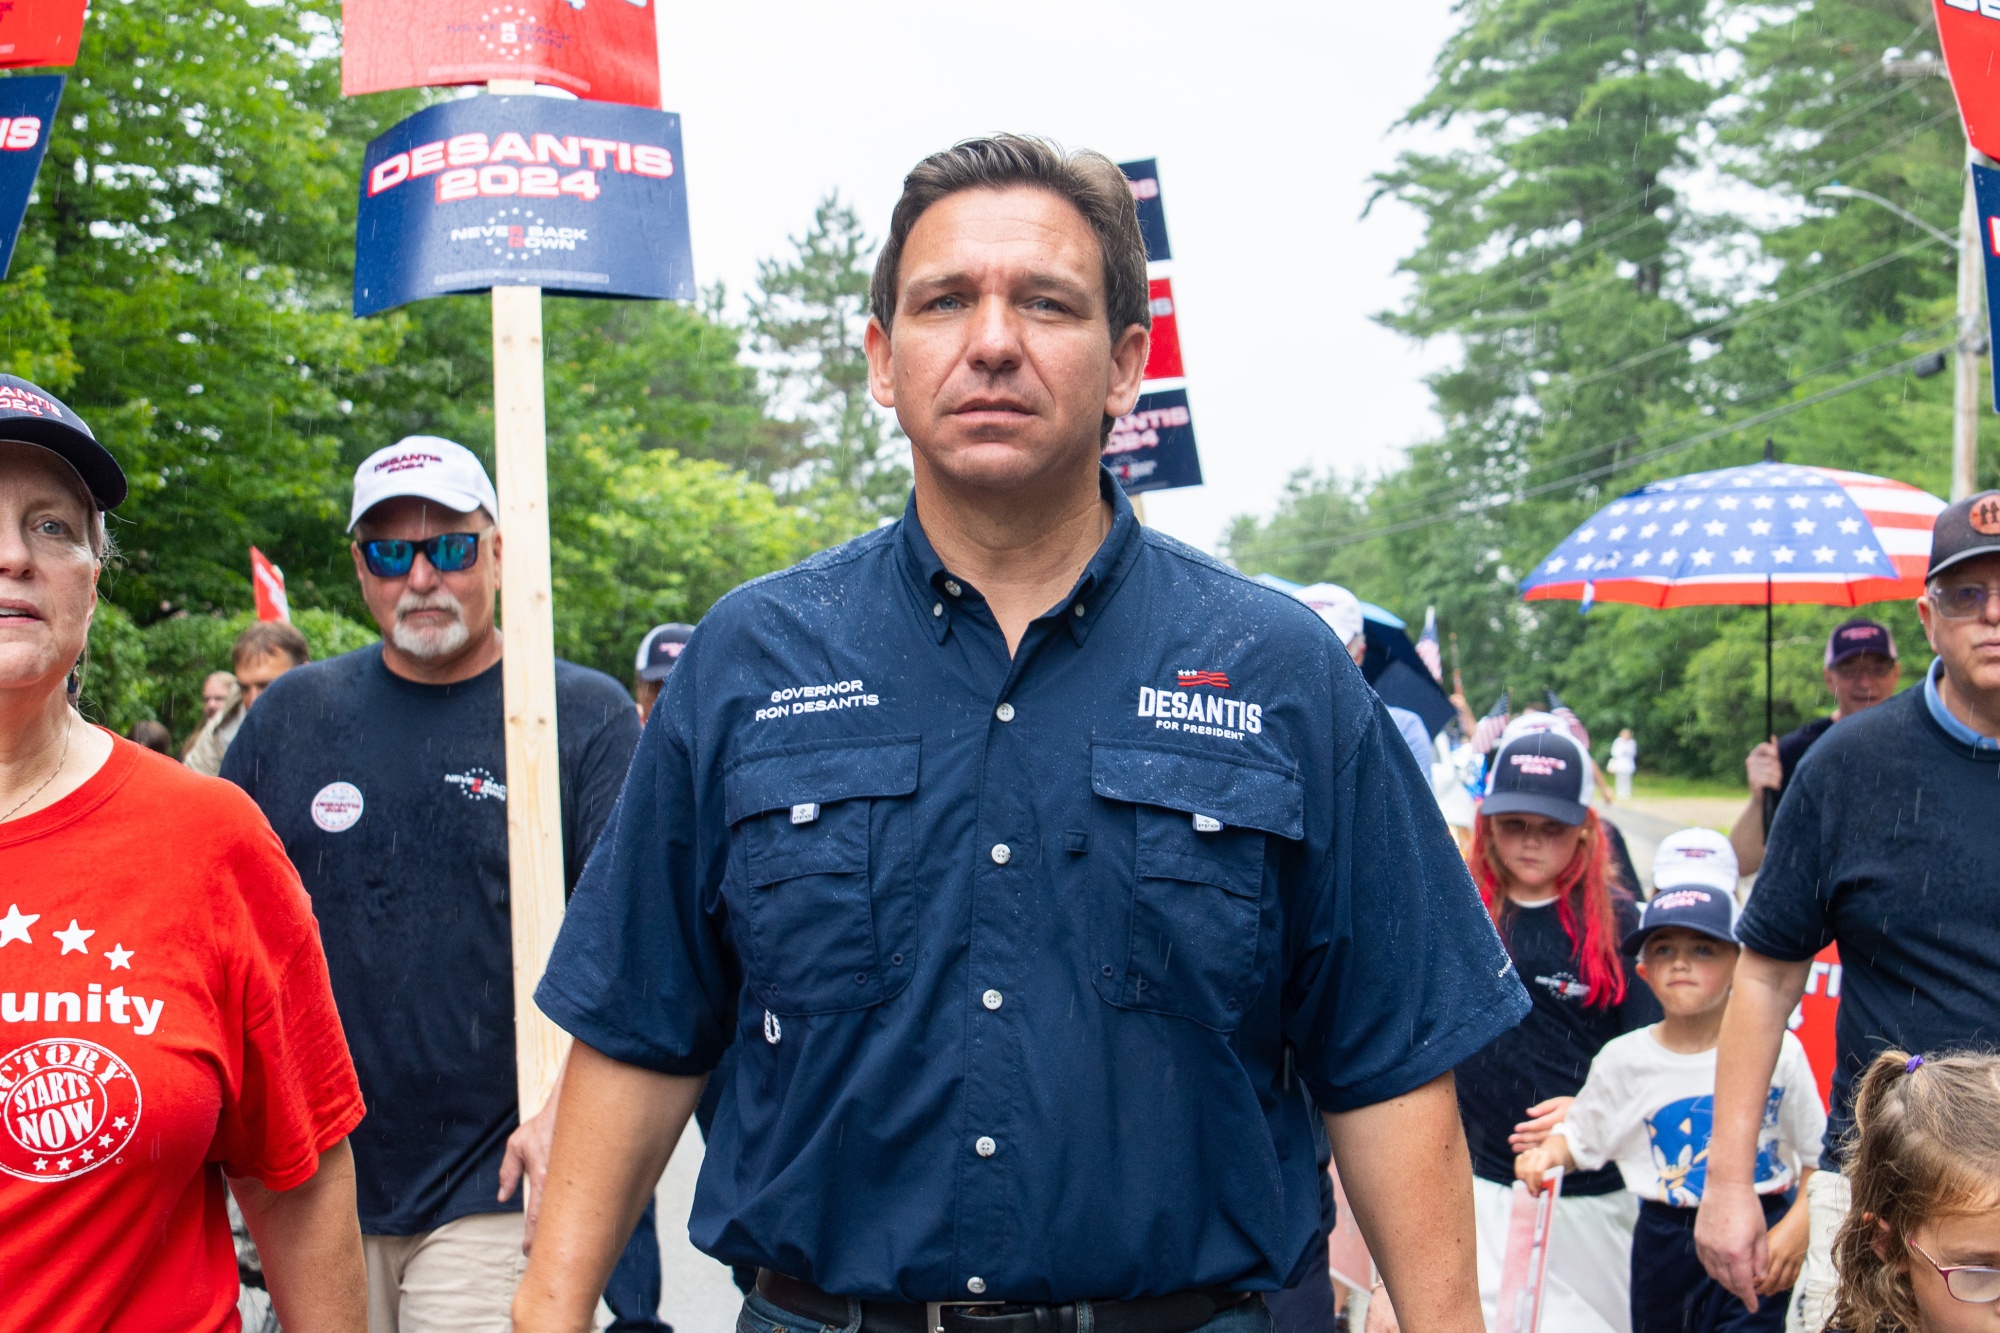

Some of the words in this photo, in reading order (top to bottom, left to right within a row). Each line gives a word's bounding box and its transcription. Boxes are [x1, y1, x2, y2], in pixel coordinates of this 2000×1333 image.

[368, 132, 674, 197] DESANTIS
[435, 166, 600, 204] 2024
[451, 225, 523, 241] NEVER
[528, 226, 588, 240] BACK
[509, 238, 575, 250] DOWN
[1102, 428, 1159, 455] 024
[374, 453, 443, 473] DESANTIS
[770, 679, 864, 703] GOVERNOR
[755, 704, 790, 722] RON
[792, 693, 880, 715] DESANTIS
[1137, 685, 1263, 735] DESANTIS
[1156, 719, 1179, 731] FOR
[1182, 722, 1246, 741] PRESIDENT
[443, 773, 482, 786] NEVER
[483, 779, 507, 793] BAC
[470, 784, 506, 801] DOWN
[1, 982, 165, 1035] unity
[0, 1044, 127, 1104] CTORY
[14, 1071, 91, 1114] STARTS
[16, 1098, 95, 1149] NOW
